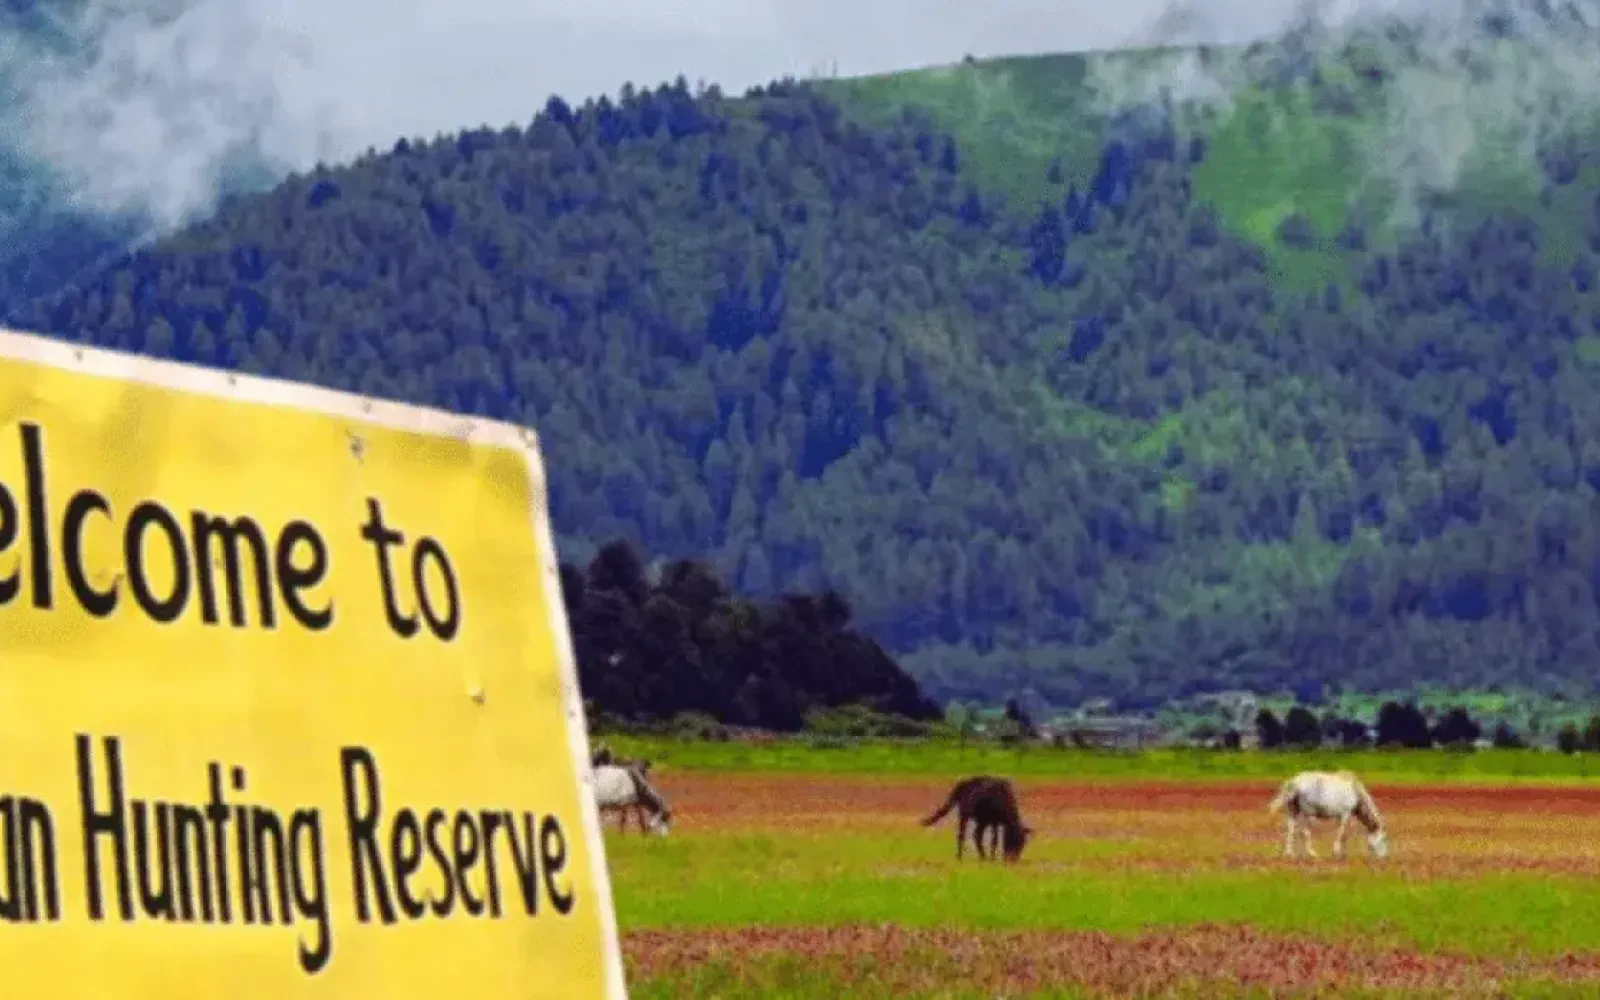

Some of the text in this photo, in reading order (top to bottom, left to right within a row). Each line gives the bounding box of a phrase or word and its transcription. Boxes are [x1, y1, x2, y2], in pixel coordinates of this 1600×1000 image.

[363, 498, 460, 641] to
[76, 733, 331, 974] Hunting
[340, 746, 574, 924] Reserve
